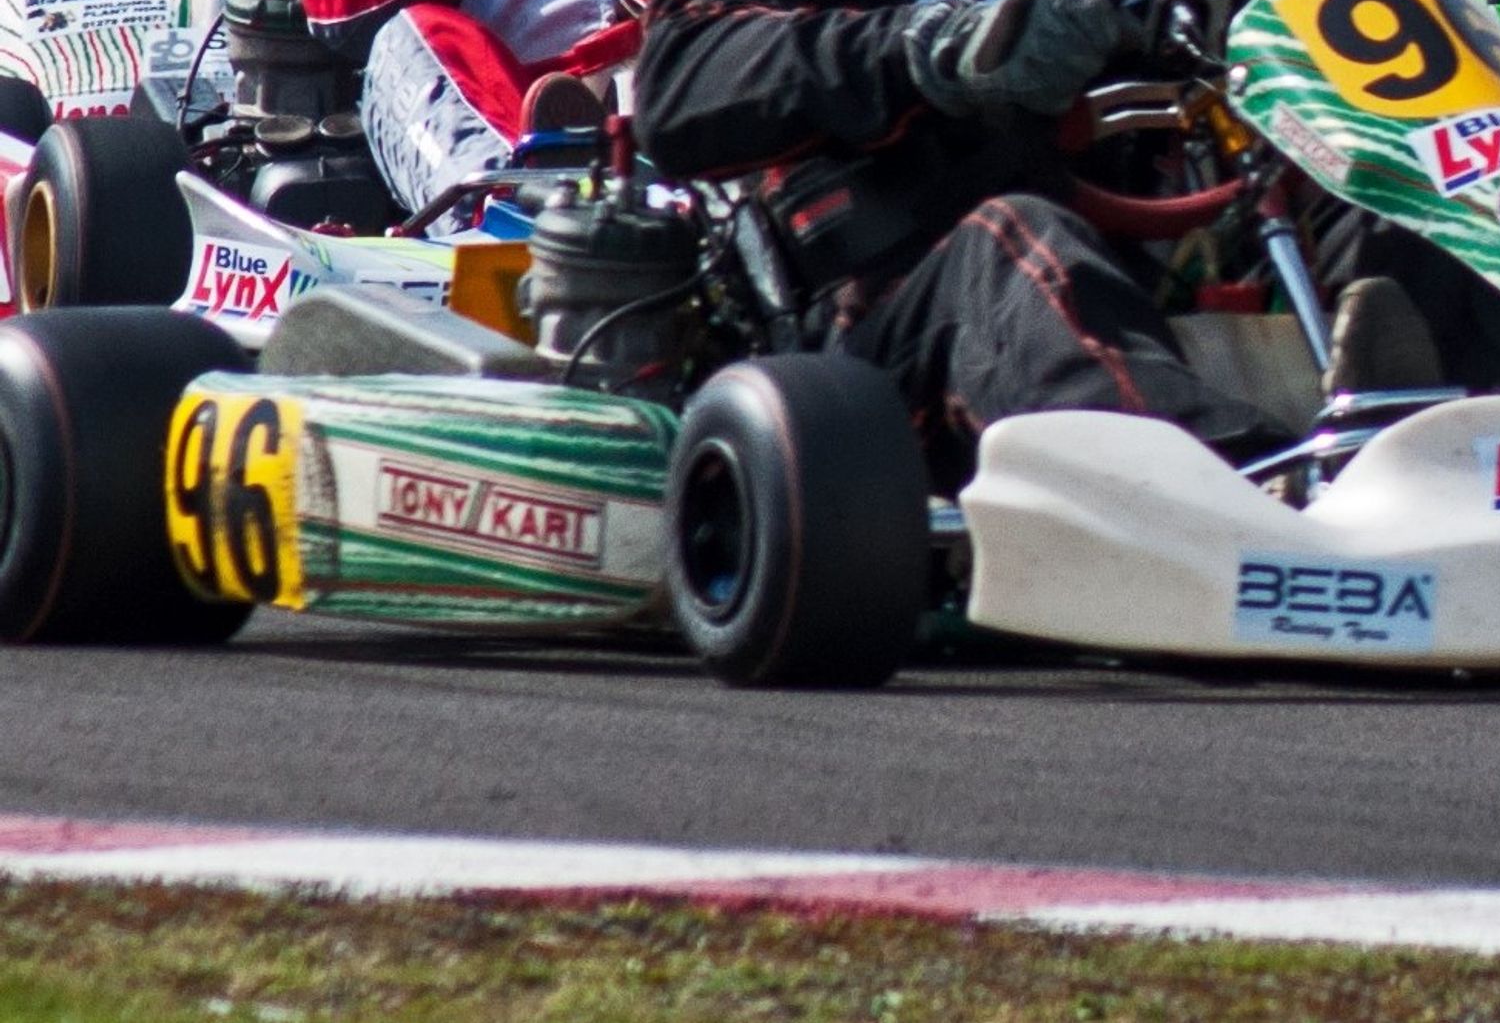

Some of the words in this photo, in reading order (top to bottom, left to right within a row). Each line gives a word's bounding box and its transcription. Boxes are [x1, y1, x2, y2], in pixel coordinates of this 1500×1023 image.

[191, 243, 293, 322] Lynx
[215, 245, 267, 276] Blue
[174, 398, 281, 603] 96
[384, 465, 470, 530] TONY
[482, 487, 598, 554] KART
[1237, 562, 1430, 621] BEBA
